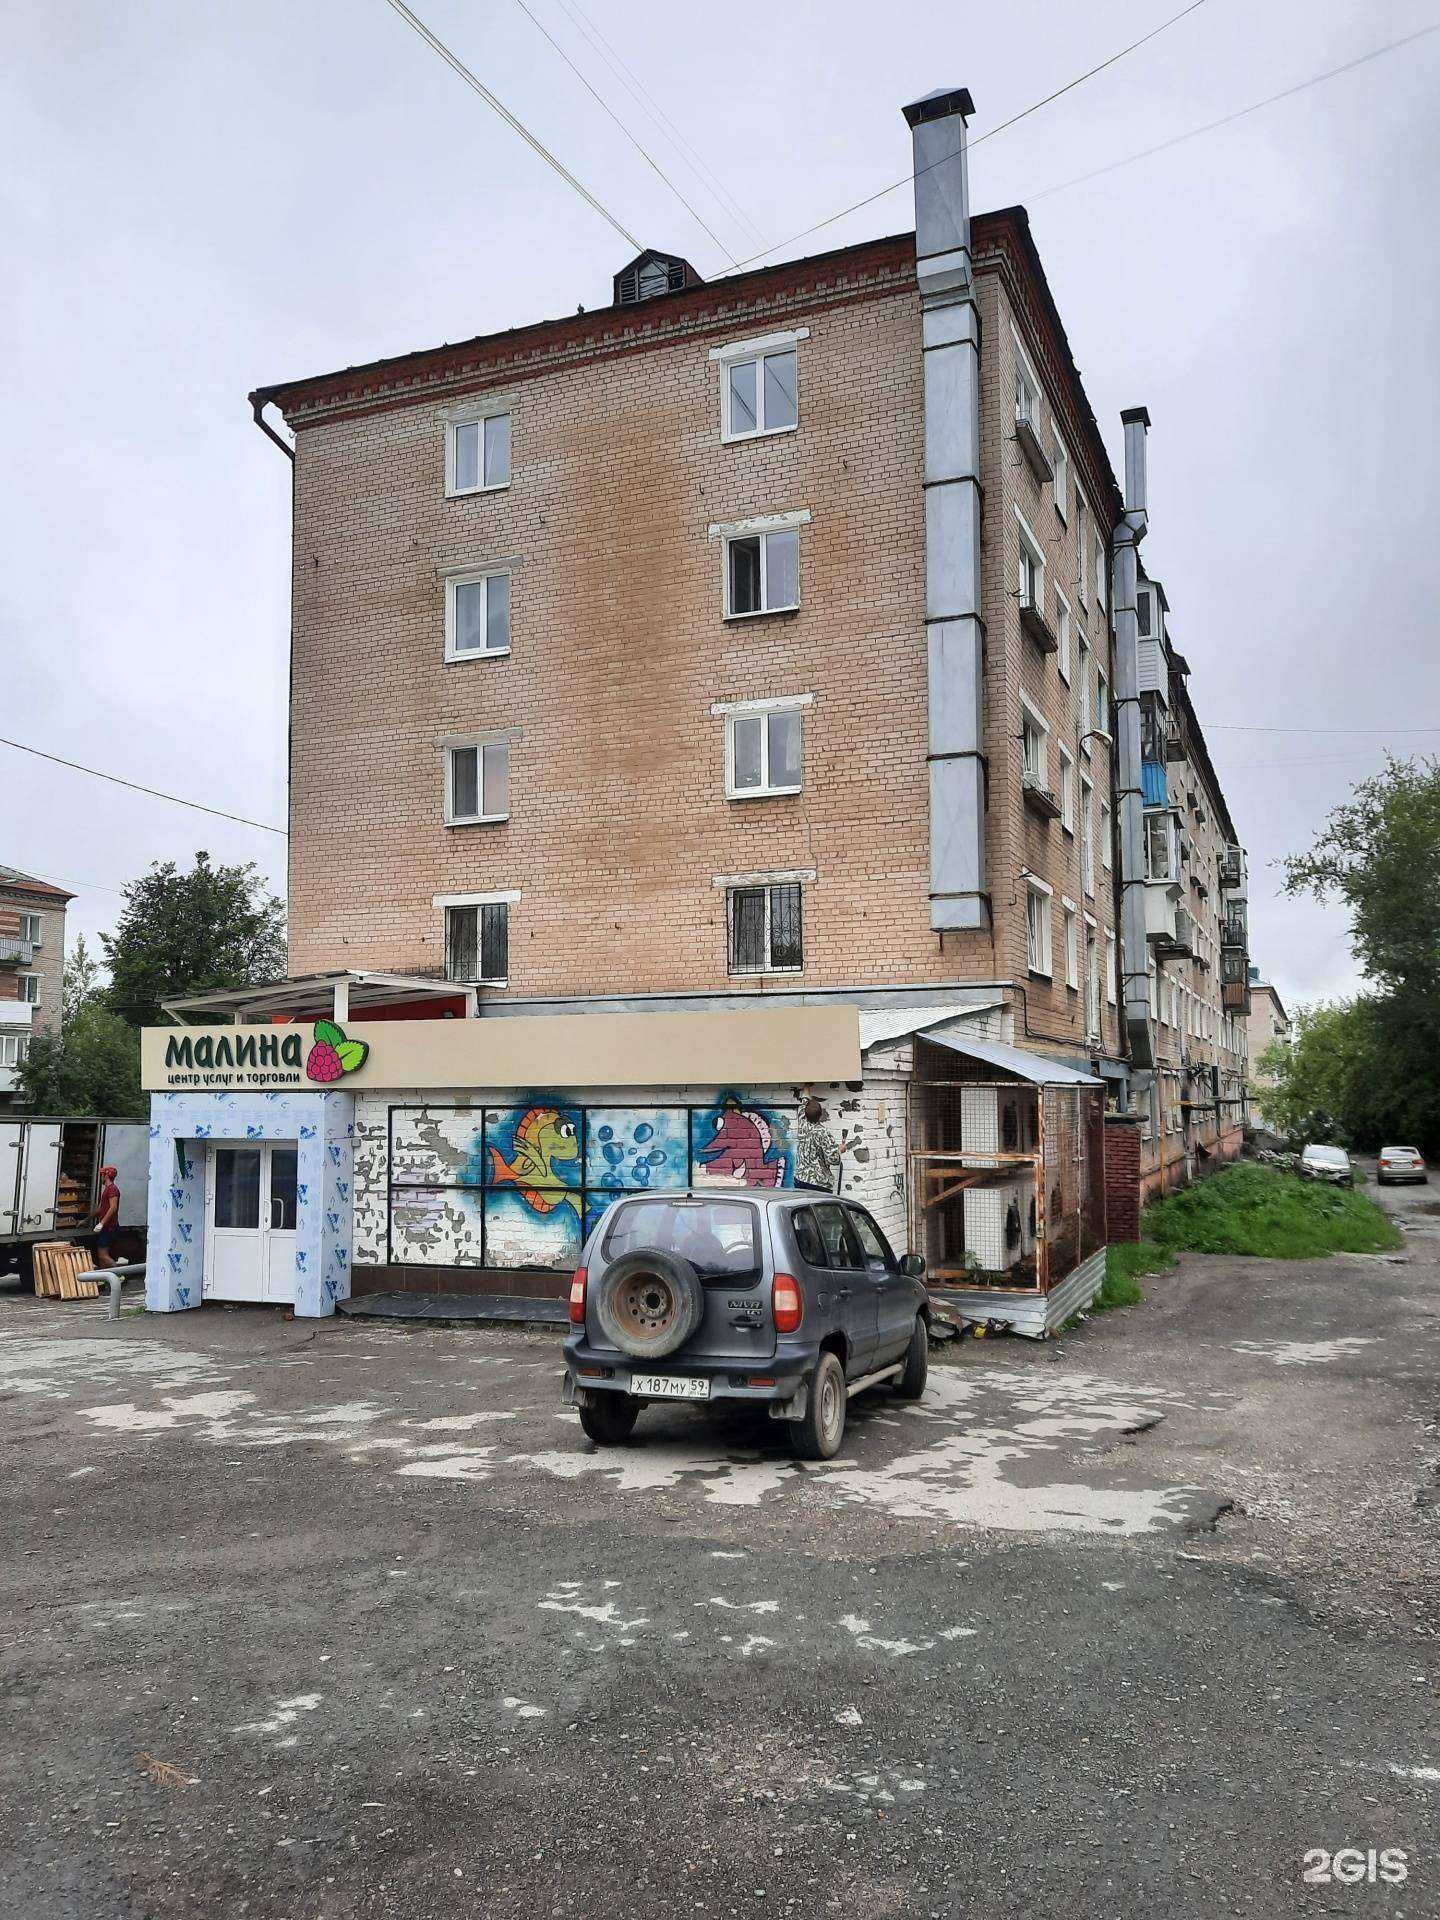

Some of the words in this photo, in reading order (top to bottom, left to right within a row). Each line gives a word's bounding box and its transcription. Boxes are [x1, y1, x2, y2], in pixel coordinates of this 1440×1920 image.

[168, 1074, 200, 1086] центр
[203, 1074, 234, 1086] услуг
[236, 1074, 244, 1083] и
[246, 1073, 300, 1086] торговли
